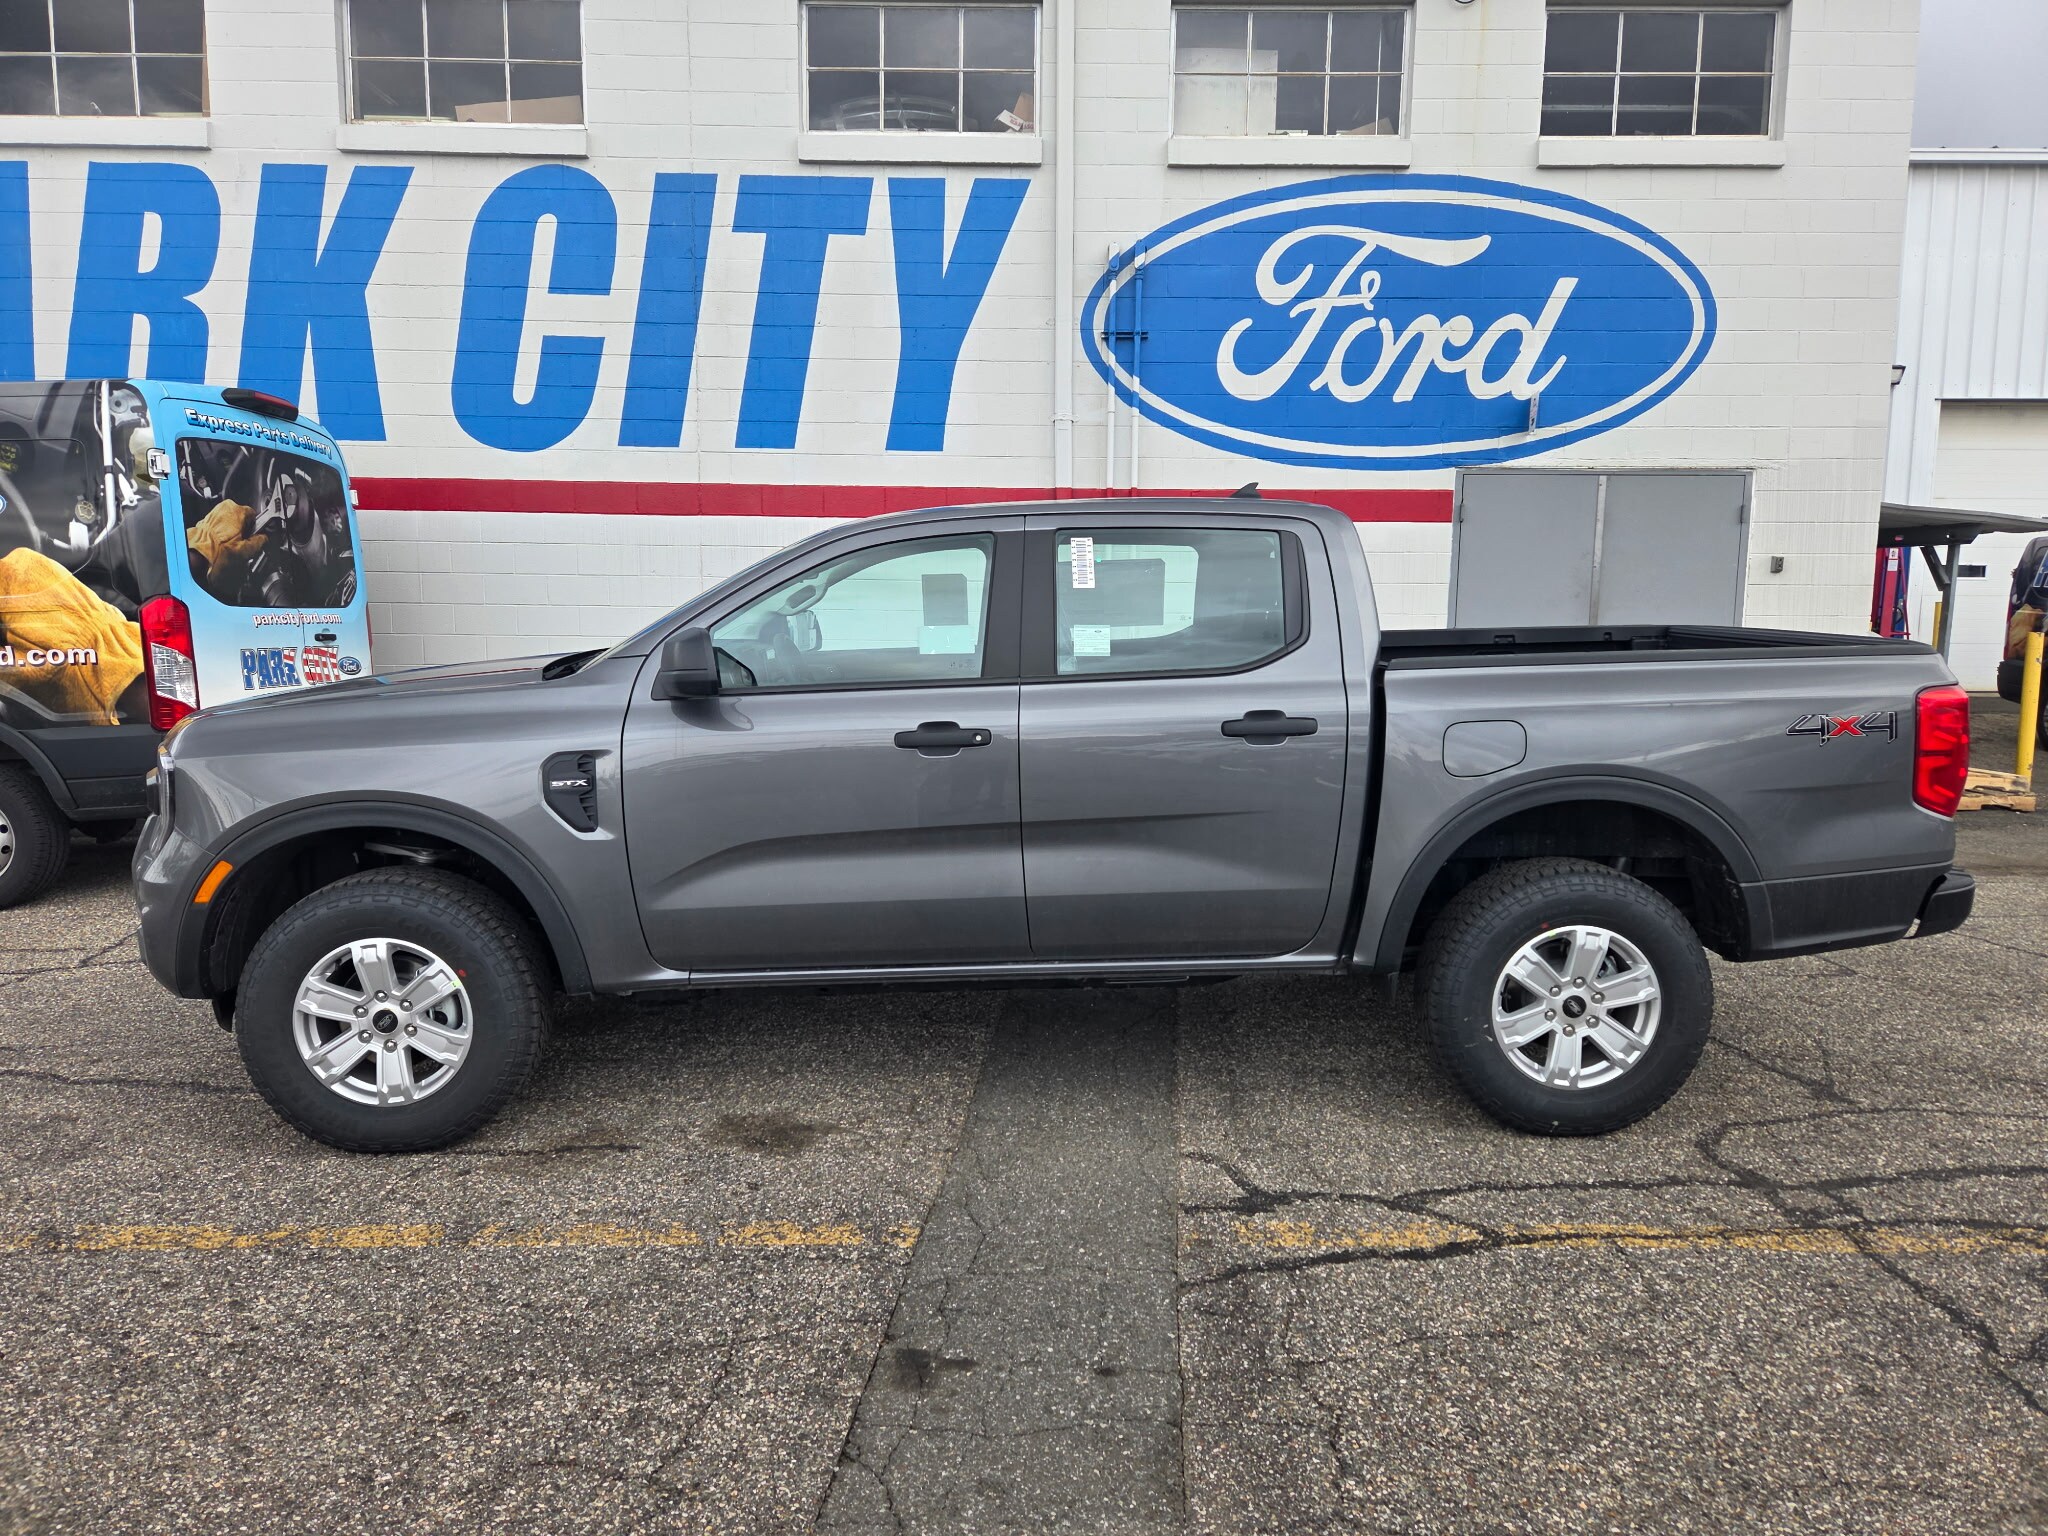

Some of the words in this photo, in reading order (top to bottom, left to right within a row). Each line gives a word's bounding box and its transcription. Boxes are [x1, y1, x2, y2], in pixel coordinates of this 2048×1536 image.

[0, 161, 415, 441] RK
[452, 164, 1031, 453] CITY
[1217, 225, 1579, 402] Ford
[184, 407, 252, 436] Express
[252, 421, 290, 445] Parts
[289, 431, 332, 460] Delivery
[252, 611, 342, 629] parkcityford.com
[240, 646, 302, 690] PARK
[301, 645, 340, 685] CITY
[551, 779, 589, 788] STX
